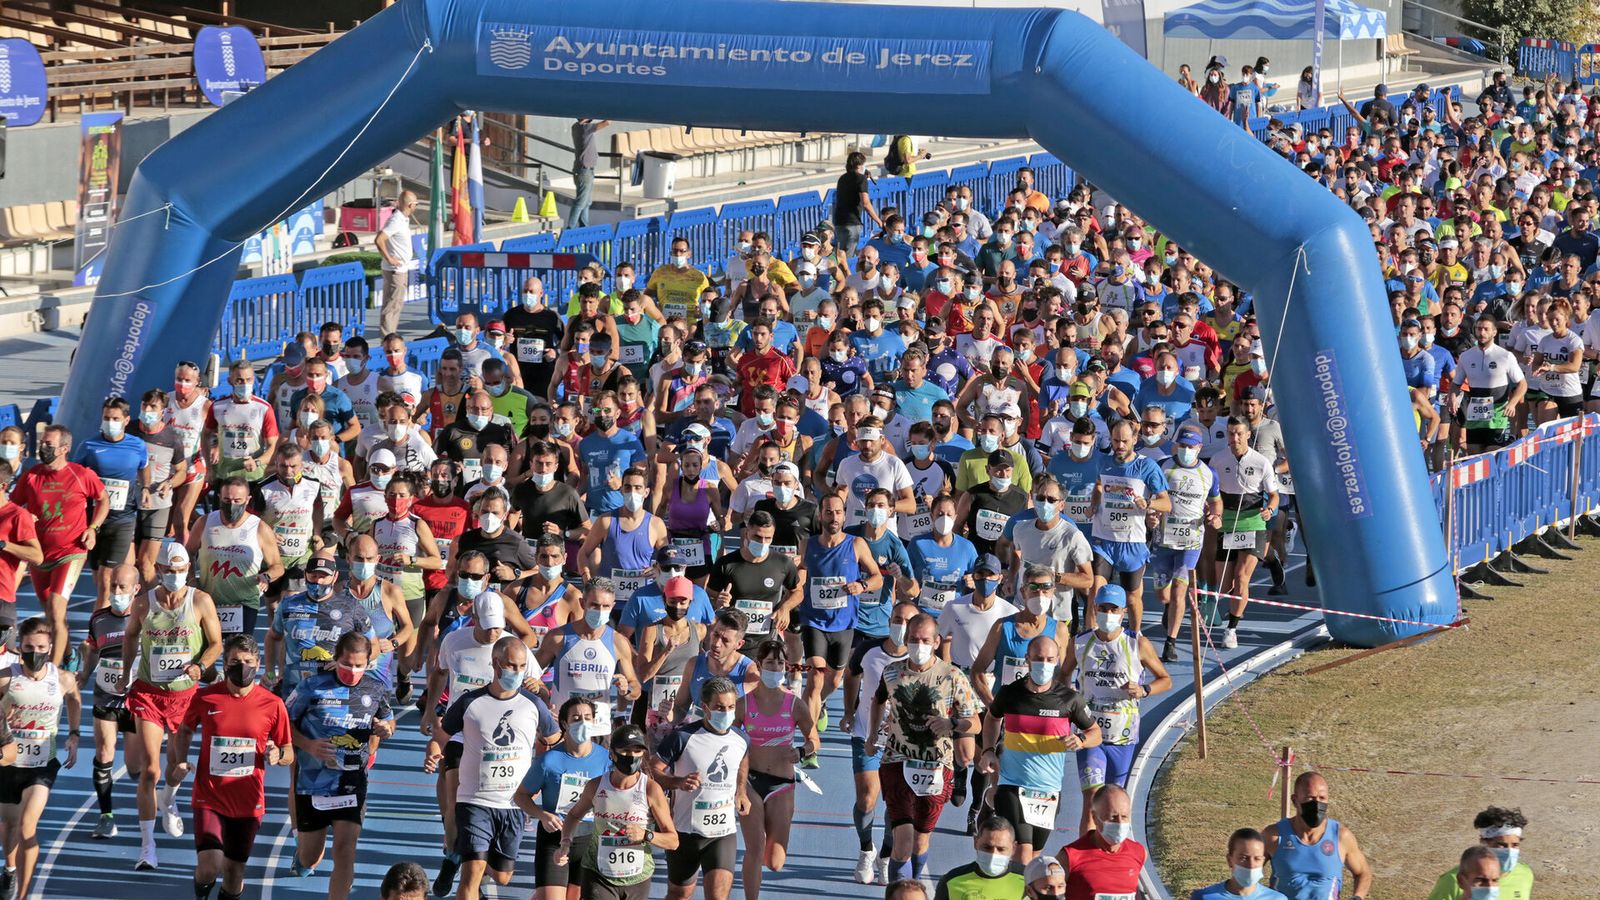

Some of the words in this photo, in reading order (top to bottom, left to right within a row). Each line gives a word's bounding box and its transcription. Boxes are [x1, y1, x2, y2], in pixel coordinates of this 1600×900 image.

[544, 36, 812, 63] Ayuntamiento
[822, 47, 866, 64] de
[875, 48, 974, 70] Jerez
[543, 57, 667, 76] Deportes
[105, 302, 151, 400] deportes@ayto
[522, 346, 538, 355] 396
[624, 348, 636, 356] 53
[1545, 373, 1560, 381] 644
[1314, 354, 1365, 514] deportes@aytojerez.es
[230, 441, 248, 450] 428
[913, 516, 931, 528] 268
[1109, 512, 1128, 522] 505
[983, 521, 1003, 533] 873
[1172, 527, 1191, 537] 758
[1234, 534, 1246, 542] 30
[619, 581, 639, 591] 548
[819, 589, 839, 599] 827
[931, 592, 945, 603] 48
[145, 626, 195, 637] maratón
[159, 659, 183, 671] 922
[567, 662, 609, 673] LEBRIJA
[662, 689, 677, 699] 14
[1093, 716, 1112, 729] 65
[220, 752, 245, 765] 231
[490, 765, 515, 778] 739
[912, 773, 935, 786] 972
[594, 811, 644, 823] maratón
[702, 812, 728, 826] 582
[608, 851, 635, 864] 916
